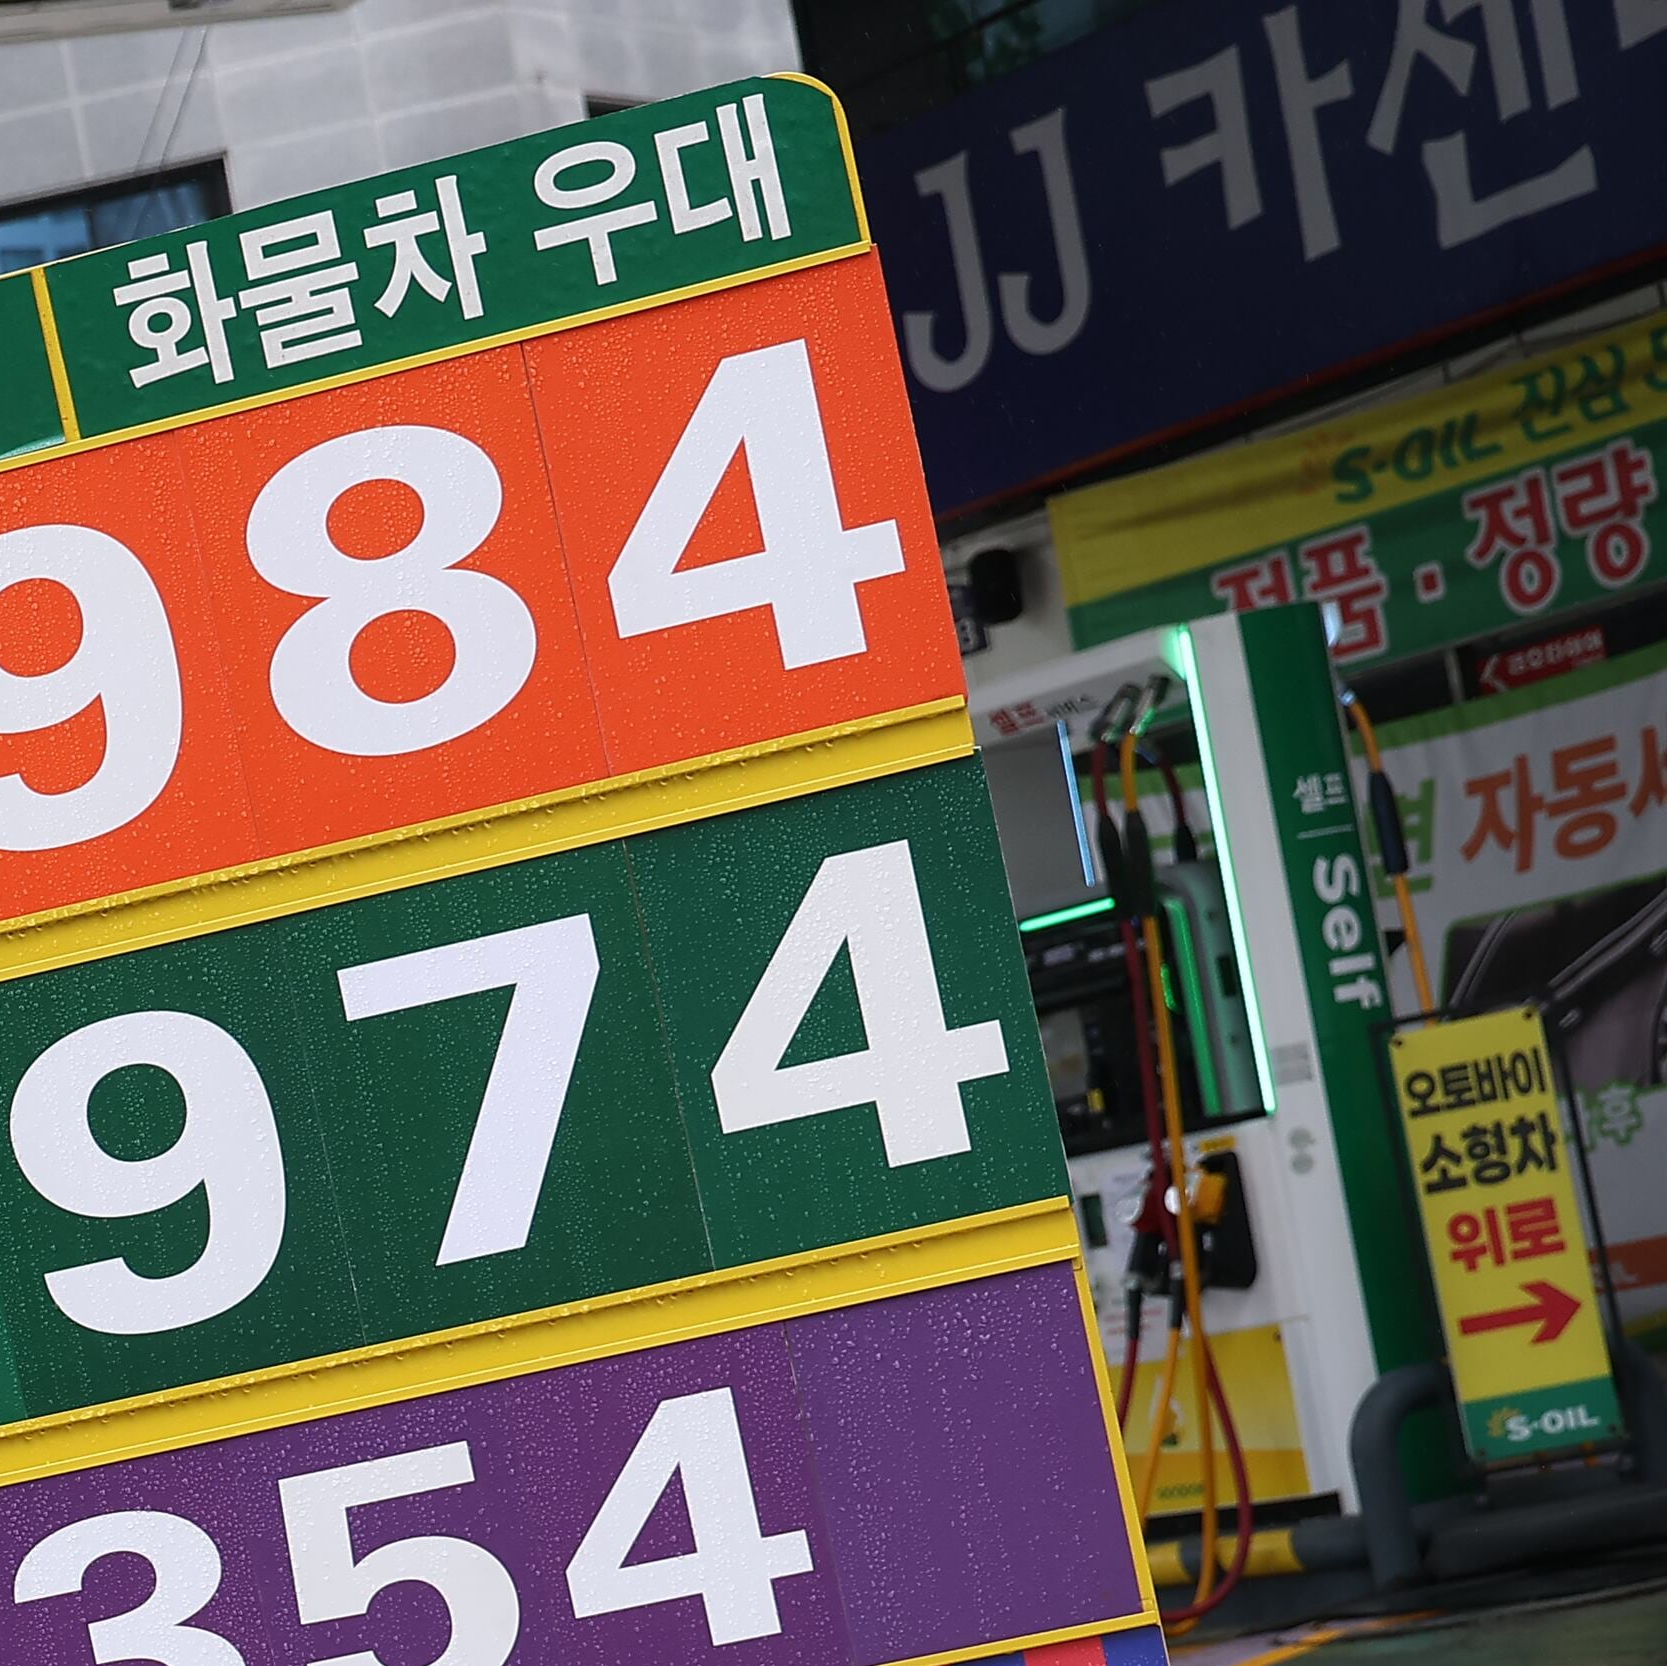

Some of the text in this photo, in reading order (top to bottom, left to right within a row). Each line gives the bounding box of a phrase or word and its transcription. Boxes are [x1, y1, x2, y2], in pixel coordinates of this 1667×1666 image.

[114, 93, 793, 390] 화물차 우대
[903, 0, 1667, 394] JJ 카센
[1463, 438, 1656, 617] 정량
[1313, 853, 1383, 1009] Self
[1404, 1046, 1548, 1119] 오토바이
[1421, 1113, 1559, 1195] 소형차
[1447, 1197, 1567, 1273] 위로
